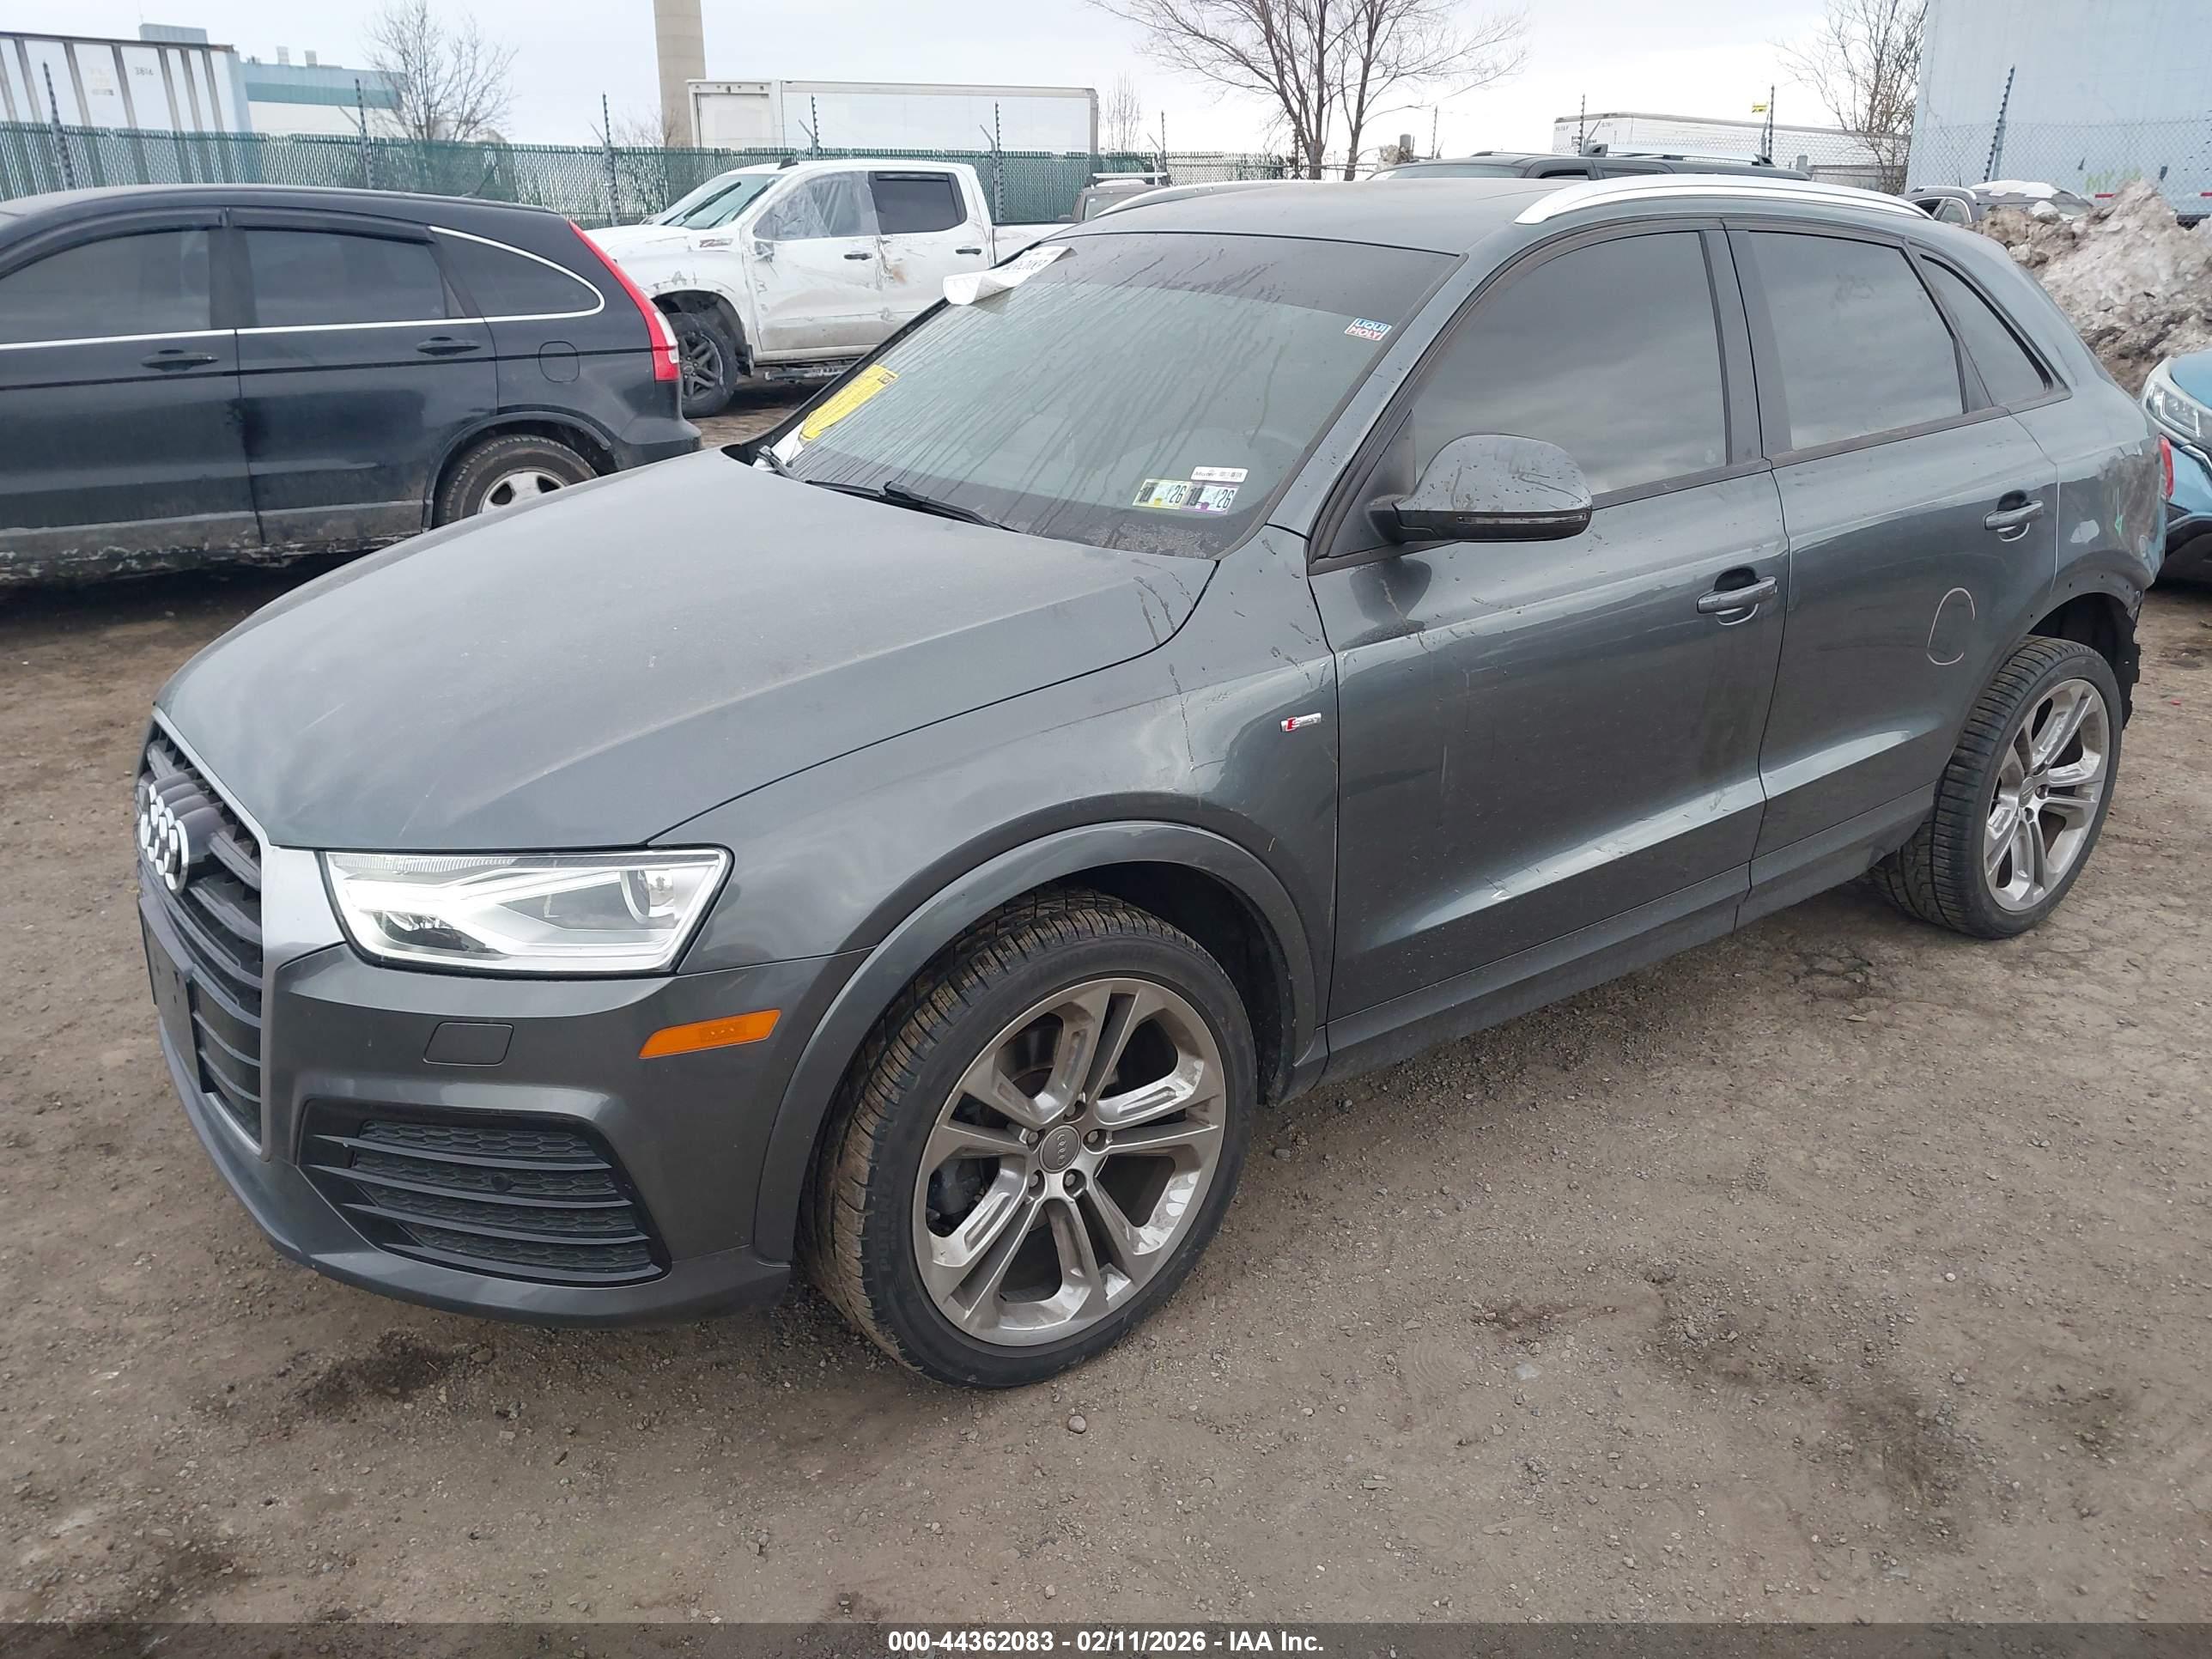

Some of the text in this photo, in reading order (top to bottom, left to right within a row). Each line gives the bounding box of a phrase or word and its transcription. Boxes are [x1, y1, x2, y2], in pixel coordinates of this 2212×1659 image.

[1348, 325, 1382, 340] MOLY
[1355, 319, 1388, 332] LIQUI
[1169, 484, 1188, 504] 26
[1216, 489, 1235, 509] 26
